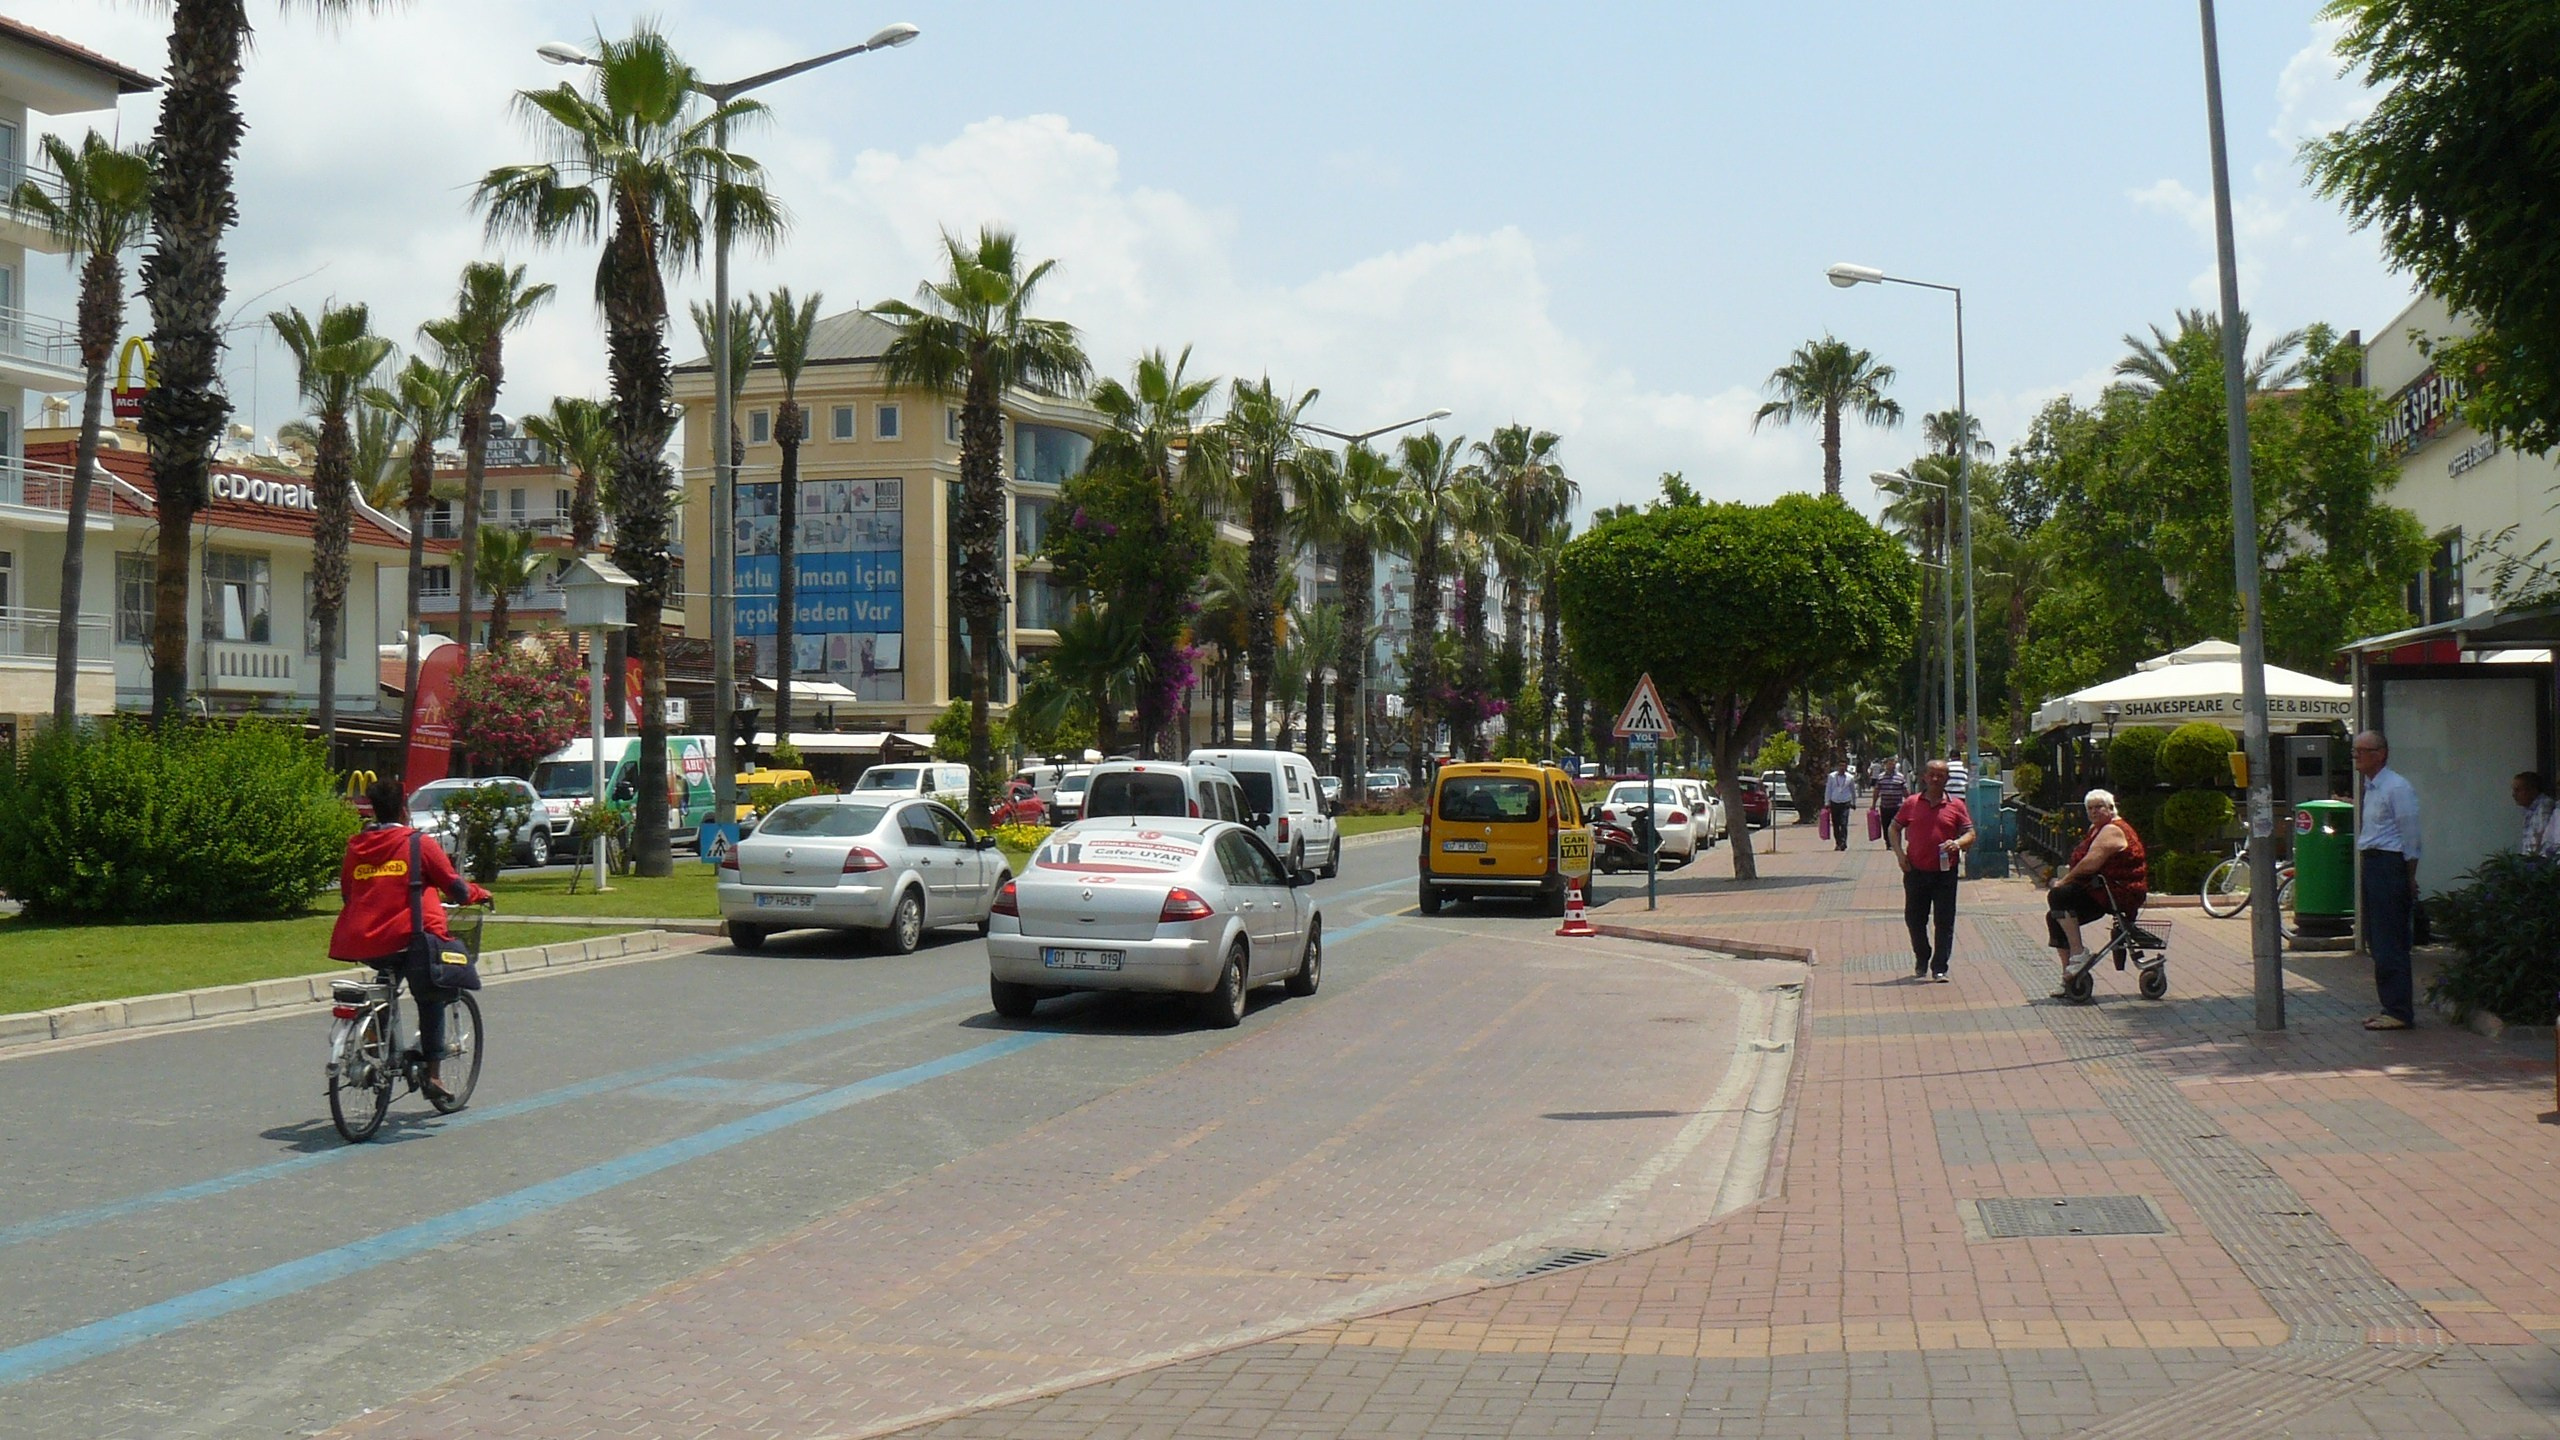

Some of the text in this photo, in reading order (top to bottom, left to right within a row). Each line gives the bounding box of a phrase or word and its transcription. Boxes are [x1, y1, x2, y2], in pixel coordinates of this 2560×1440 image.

[484, 449, 516, 458] CASH
[793, 566, 848, 587] lman
[855, 559, 897, 591] İçin
[854, 600, 892, 621] Var
[2125, 698, 2351, 716] SHAKESPEARE CEE & BISTRO
[1635, 732, 1654, 741] YOL
[1094, 848, 1183, 863] Cafer UYAR
[1562, 845, 1586, 857] TAXI
[1054, 951, 1118, 965] 01 TC 019
